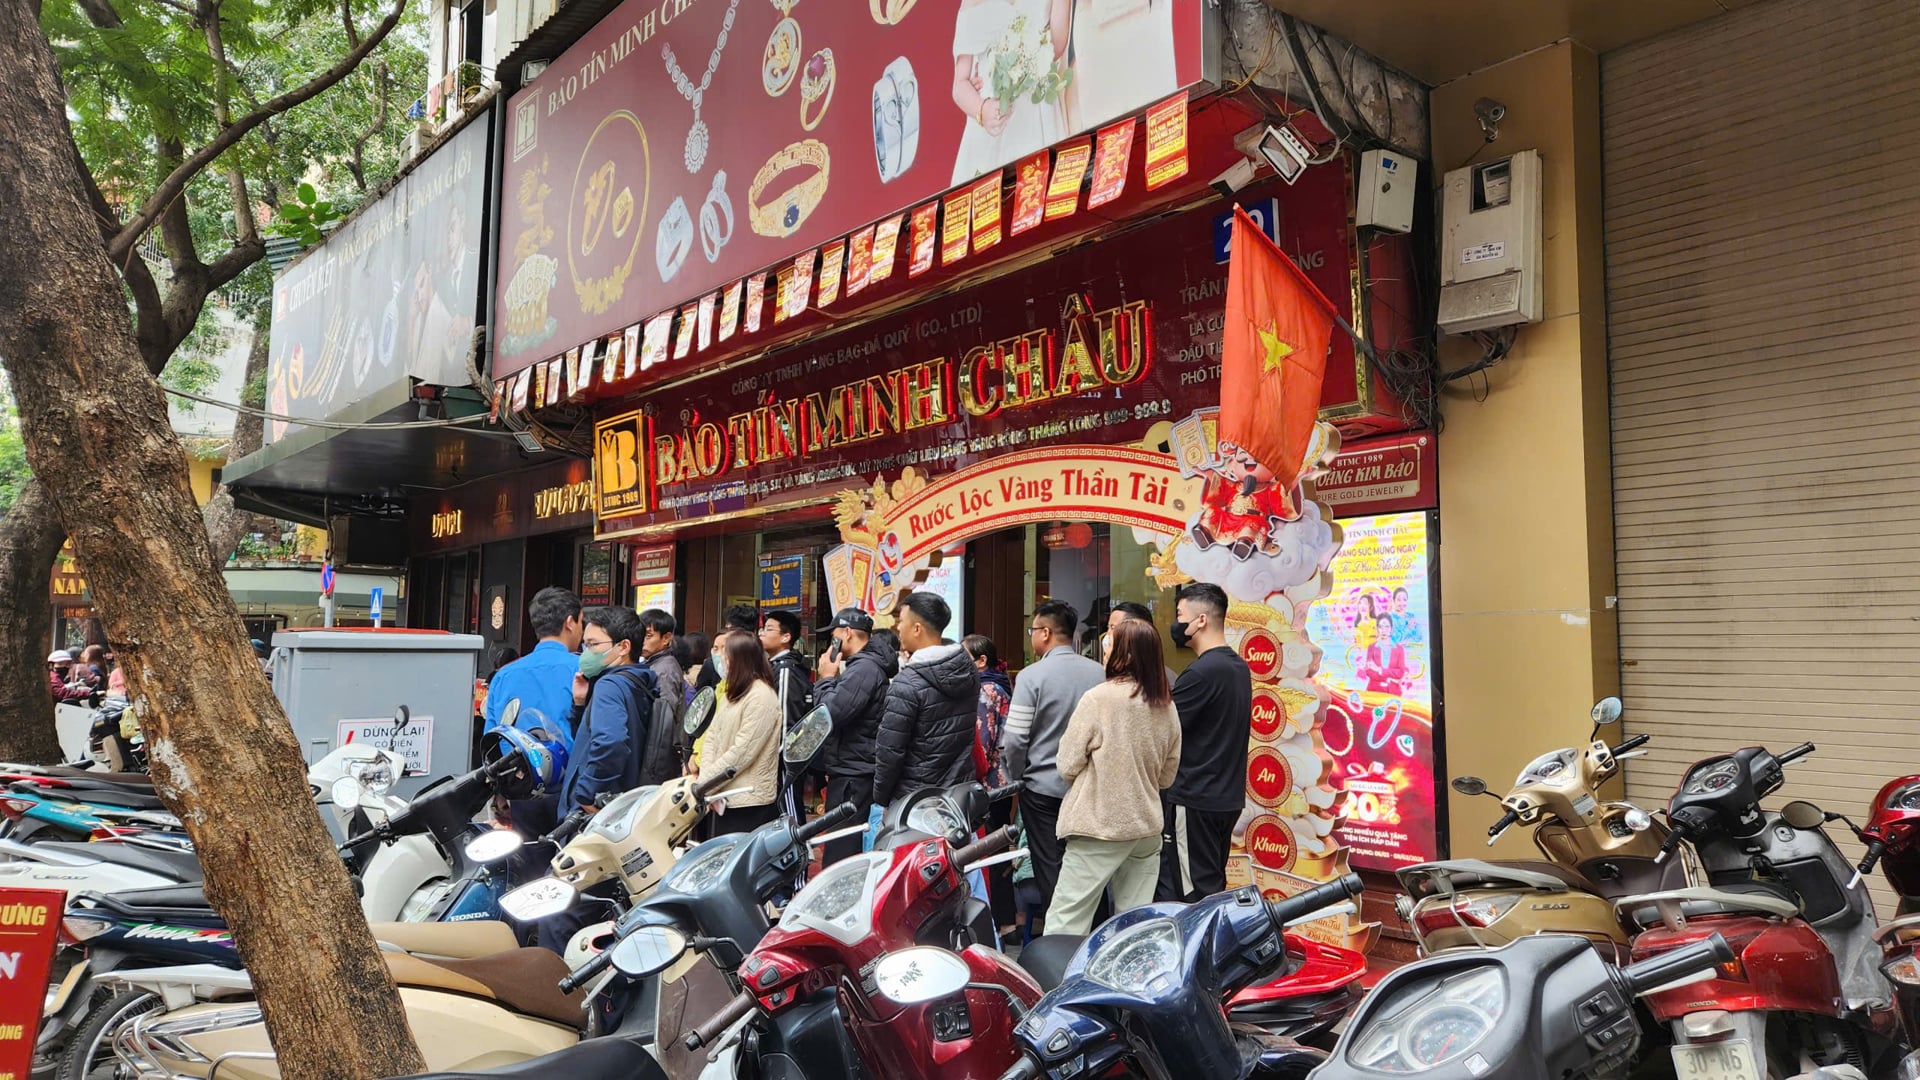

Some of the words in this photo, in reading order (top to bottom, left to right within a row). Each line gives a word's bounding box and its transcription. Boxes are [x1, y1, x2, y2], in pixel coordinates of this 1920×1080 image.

[547, 75, 578, 117] BẢO
[580, 50, 607, 91] TÍN
[609, 8, 657, 68] MINH
[775, 364, 803, 383] TNHH
[950, 302, 983, 329] LTD)
[654, 408, 722, 486] BẢO
[728, 388, 799, 470] TÍN
[805, 356, 950, 452] MINH
[958, 292, 1147, 418] CHÂU
[1336, 456, 1362, 467] BTMC
[1363, 454, 1384, 465] 1989
[1317, 467, 1354, 488] OÀNG
[1355, 464, 1381, 483] KIM
[1383, 458, 1415, 480] BẢO
[1340, 489, 1364, 500] GOLD
[1366, 485, 1405, 497] JEWELRY
[909, 502, 955, 540] Rước
[959, 486, 994, 517] Lộc
[998, 475, 1054, 503] Vàng
[1060, 467, 1119, 498] Thần
[1128, 471, 1170, 507] Tài
[1245, 647, 1276, 665] Sang
[1252, 704, 1277, 725] Quý
[402, 726, 425, 738] LẠI!
[1256, 766, 1276, 783] An
[1253, 836, 1290, 862] Khang
[1530, 903, 1571, 911] LEAD
[450, 911, 491, 922] HONDA
[1686, 999, 1720, 1008] HONDA
